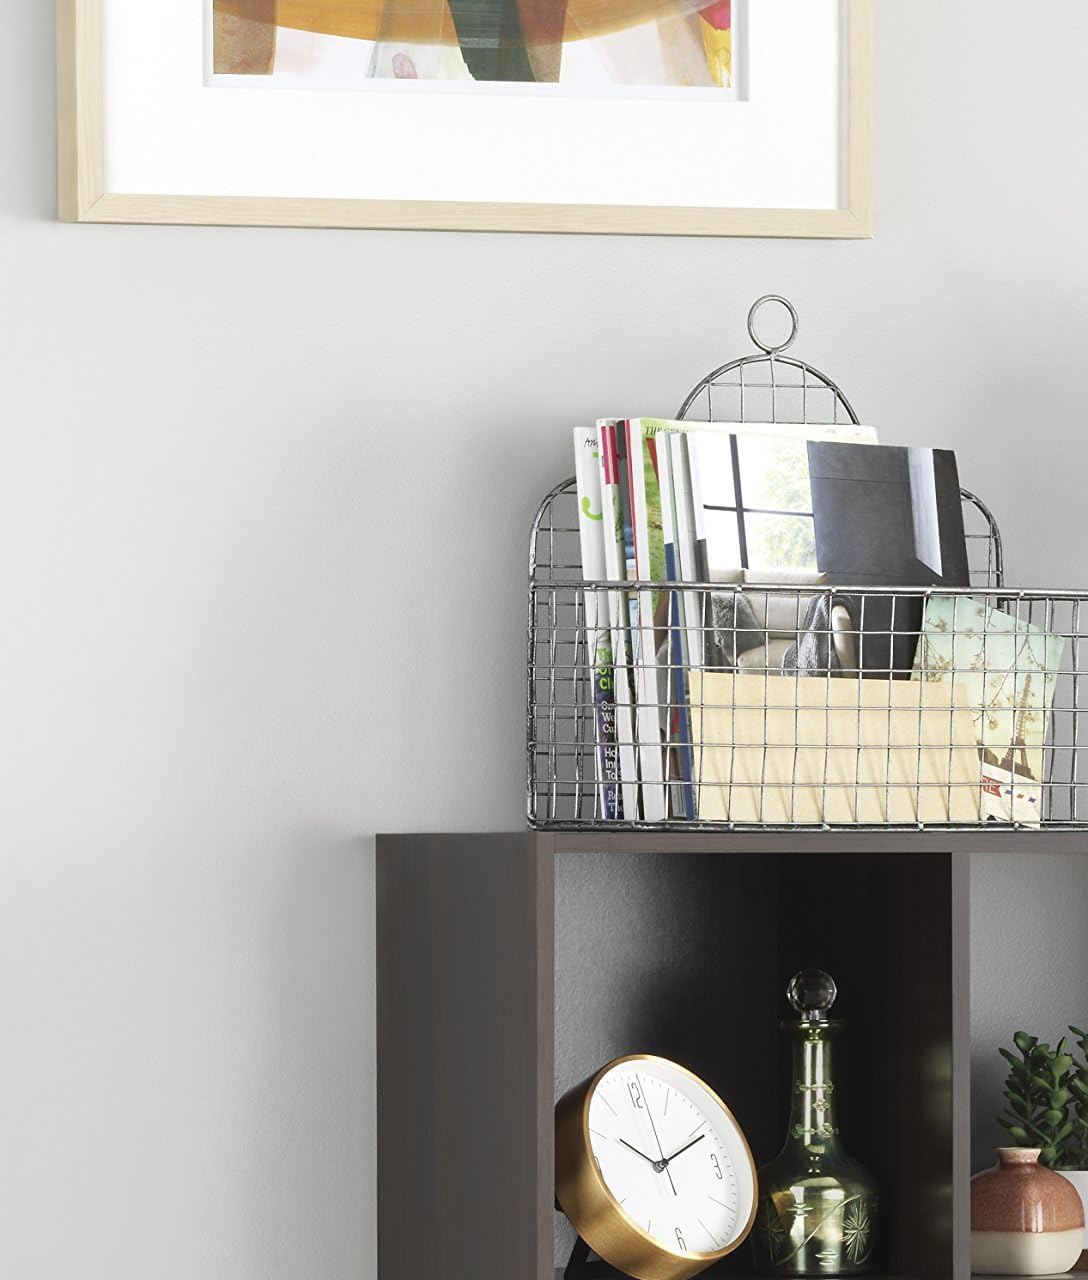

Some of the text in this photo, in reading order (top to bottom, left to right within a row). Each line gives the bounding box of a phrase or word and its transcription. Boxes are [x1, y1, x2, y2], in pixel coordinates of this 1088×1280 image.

[627, 1082, 644, 1109] 12
[711, 1153, 722, 1179] 3
[675, 1227, 688, 1251] 6
